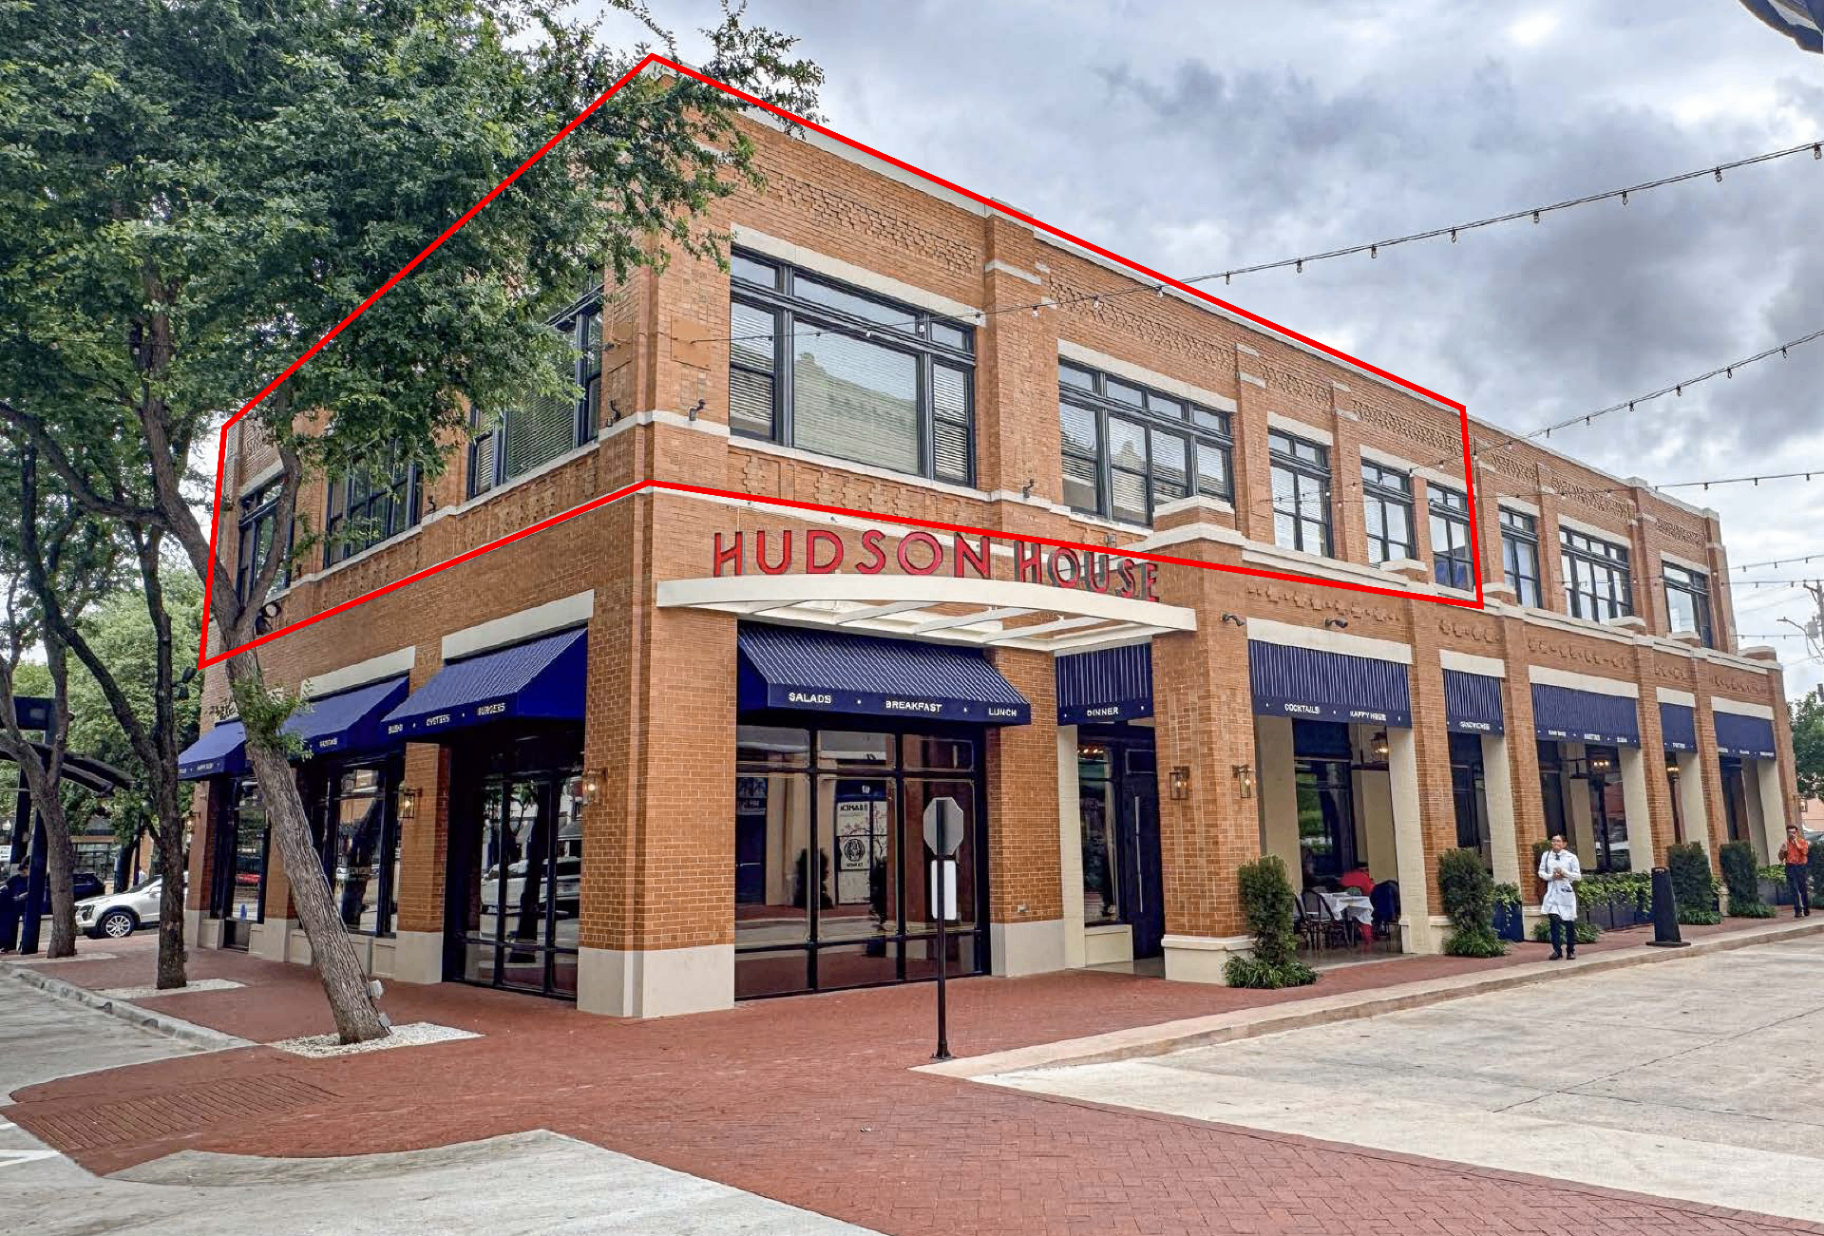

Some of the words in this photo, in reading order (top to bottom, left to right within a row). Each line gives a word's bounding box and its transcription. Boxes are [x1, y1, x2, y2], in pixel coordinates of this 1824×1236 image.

[712, 529, 991, 579] HUDSON
[1013, 539, 1160, 603] HOUSE
[788, 692, 832, 704] SALADS
[885, 700, 943, 713] BREAKFAST
[988, 707, 1018, 718] LUNCH
[1086, 706, 1119, 717] DINNER
[1284, 703, 1320, 715] COCKTAILS
